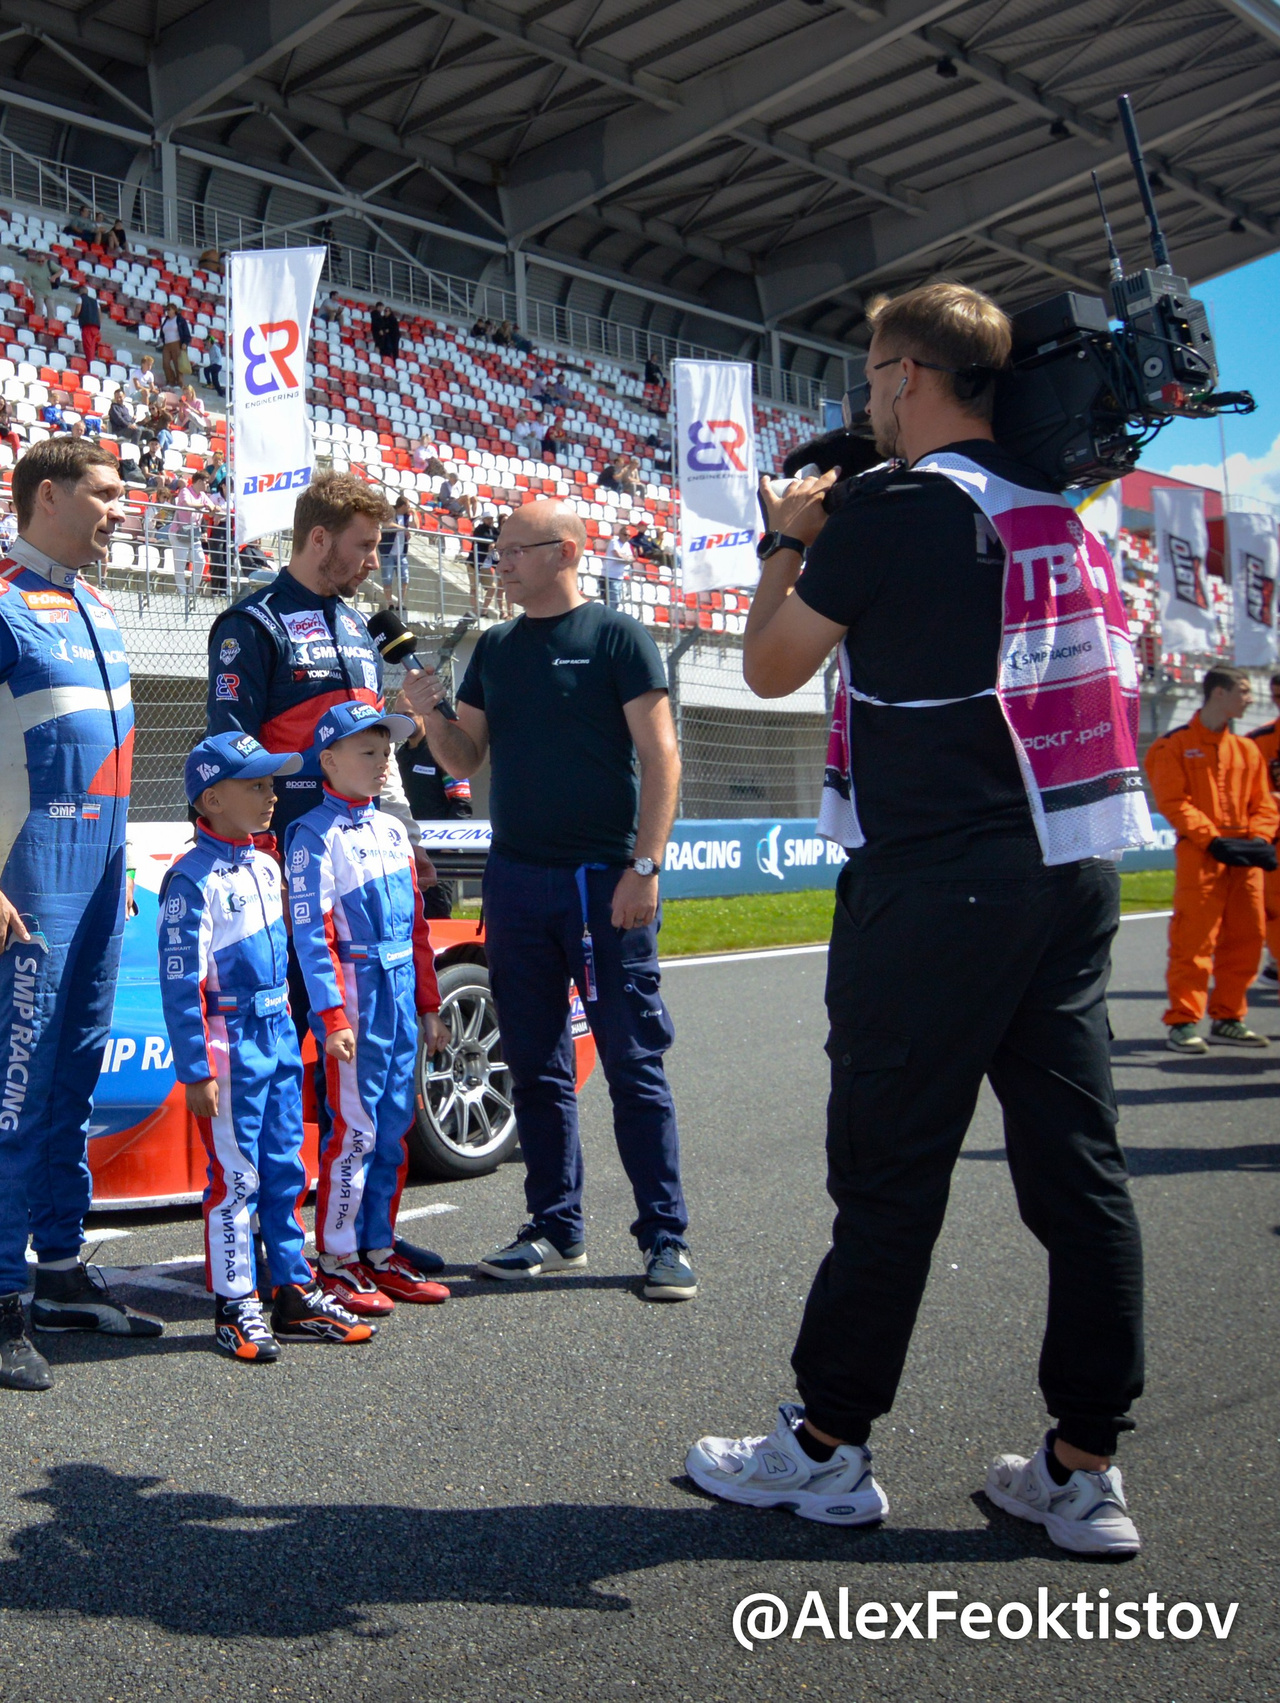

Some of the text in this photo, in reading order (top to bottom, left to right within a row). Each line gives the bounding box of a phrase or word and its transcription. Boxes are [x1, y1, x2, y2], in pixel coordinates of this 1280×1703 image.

[245, 391, 300, 409] ENGINEERING
[71, 644, 95, 661] SMP
[49, 805, 76, 816] OMP
[665, 839, 741, 871] RACING
[784, 837, 824, 866] SMP
[12, 955, 37, 1020] SMP
